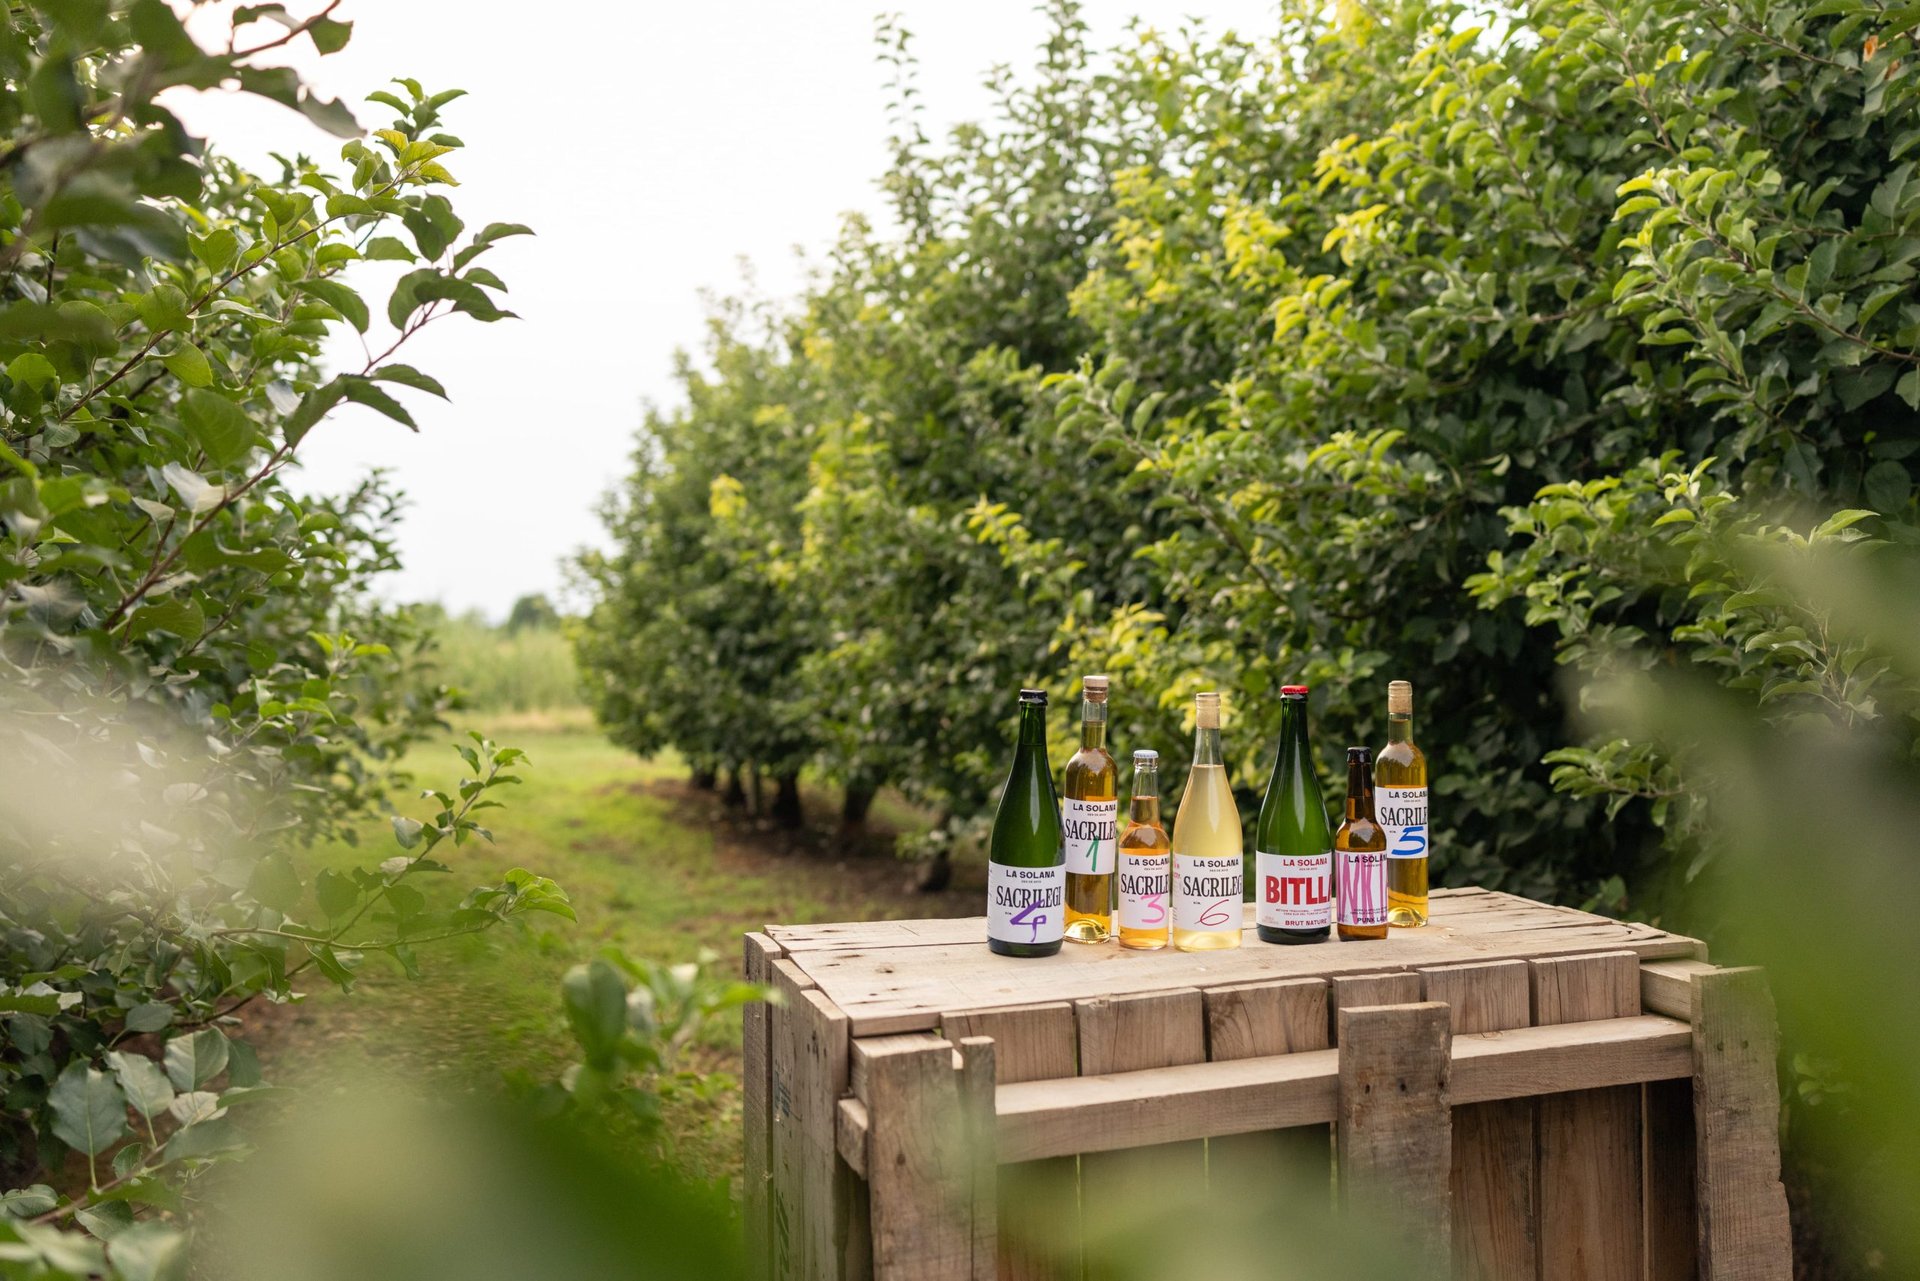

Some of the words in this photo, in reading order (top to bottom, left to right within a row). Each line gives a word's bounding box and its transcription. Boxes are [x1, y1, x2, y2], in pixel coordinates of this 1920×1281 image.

[1073, 803, 1084, 811] LA
[1391, 826, 1426, 856] 5
[1086, 835, 1100, 873] 1
[1283, 858, 1295, 866] LA
[1297, 857, 1328, 866] SOLANA
[1348, 855, 1360, 863] LA
[1207, 859, 1239, 868] SOLANA
[1006, 869, 1017, 878] LA
[1020, 870, 1055, 879] SOLANA
[996, 885, 1062, 909] SACRILEGI
[1140, 892, 1166, 925] 3
[1194, 899, 1230, 926] 6
[1009, 899, 1047, 942] 4
[1285, 919, 1305, 927] BRUT
